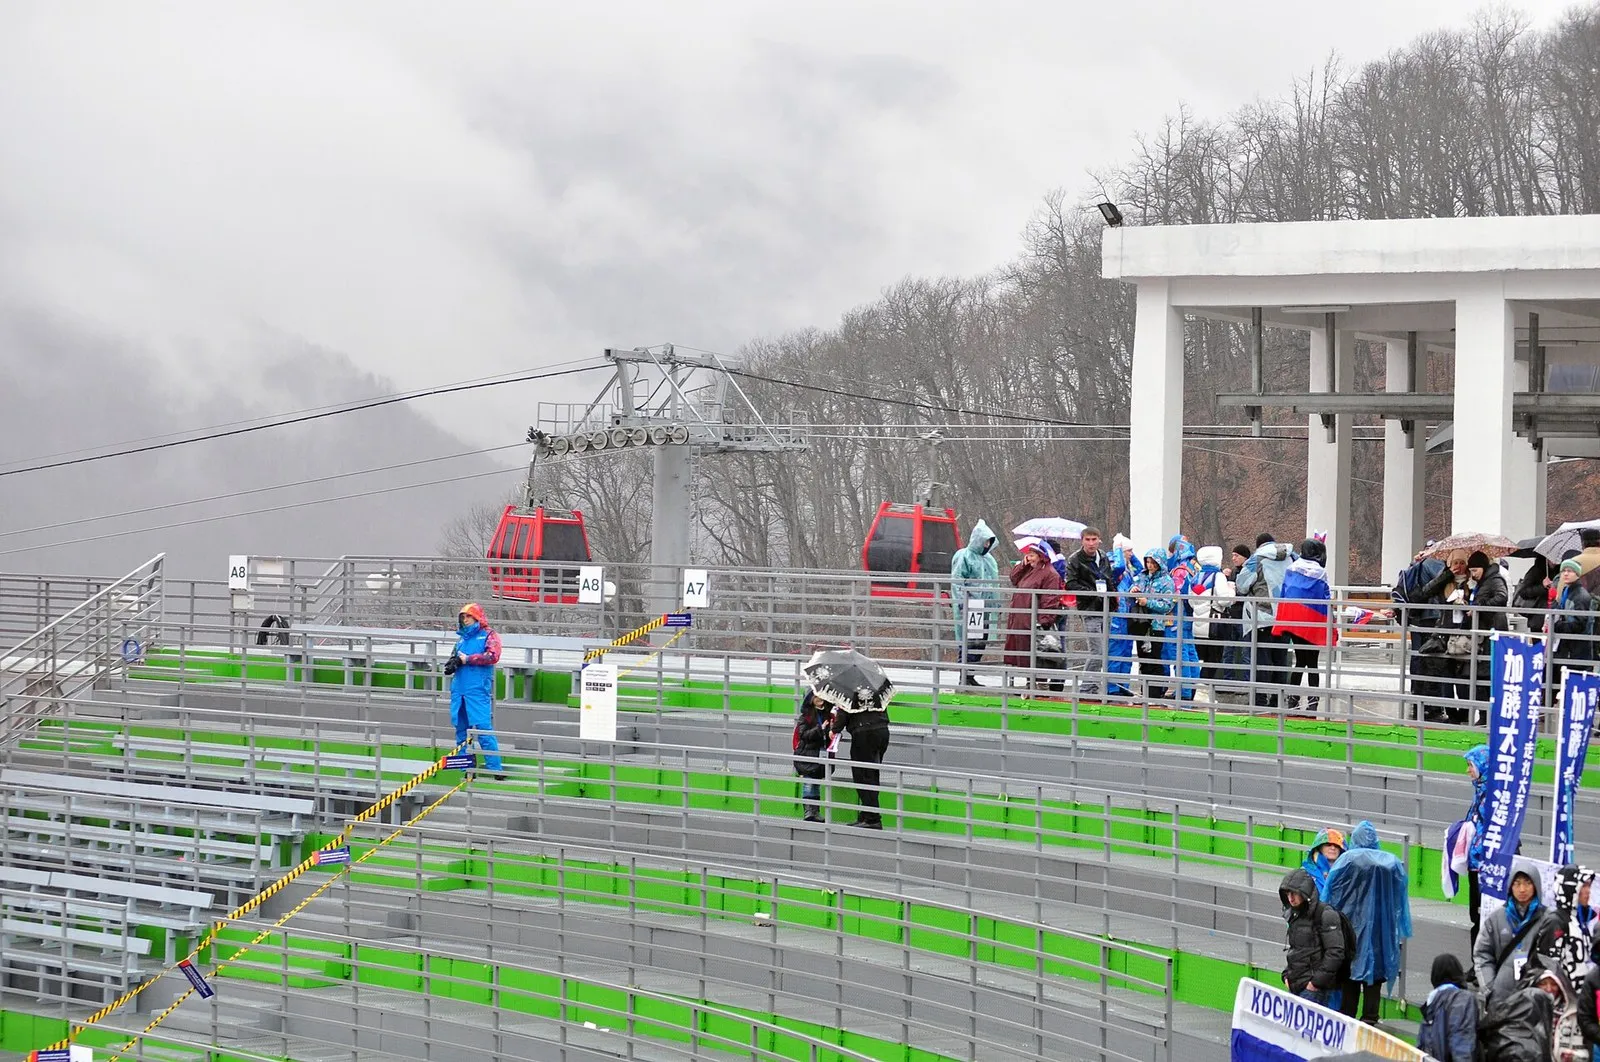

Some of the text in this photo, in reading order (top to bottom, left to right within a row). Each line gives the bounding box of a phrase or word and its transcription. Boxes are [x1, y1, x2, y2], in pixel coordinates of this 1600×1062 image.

[230, 566, 246, 578] A8
[582, 578, 600, 592] A8
[686, 582, 705, 595] A7
[969, 612, 983, 626] A7
[1250, 986, 1347, 1050] КОСМОДРОМ
